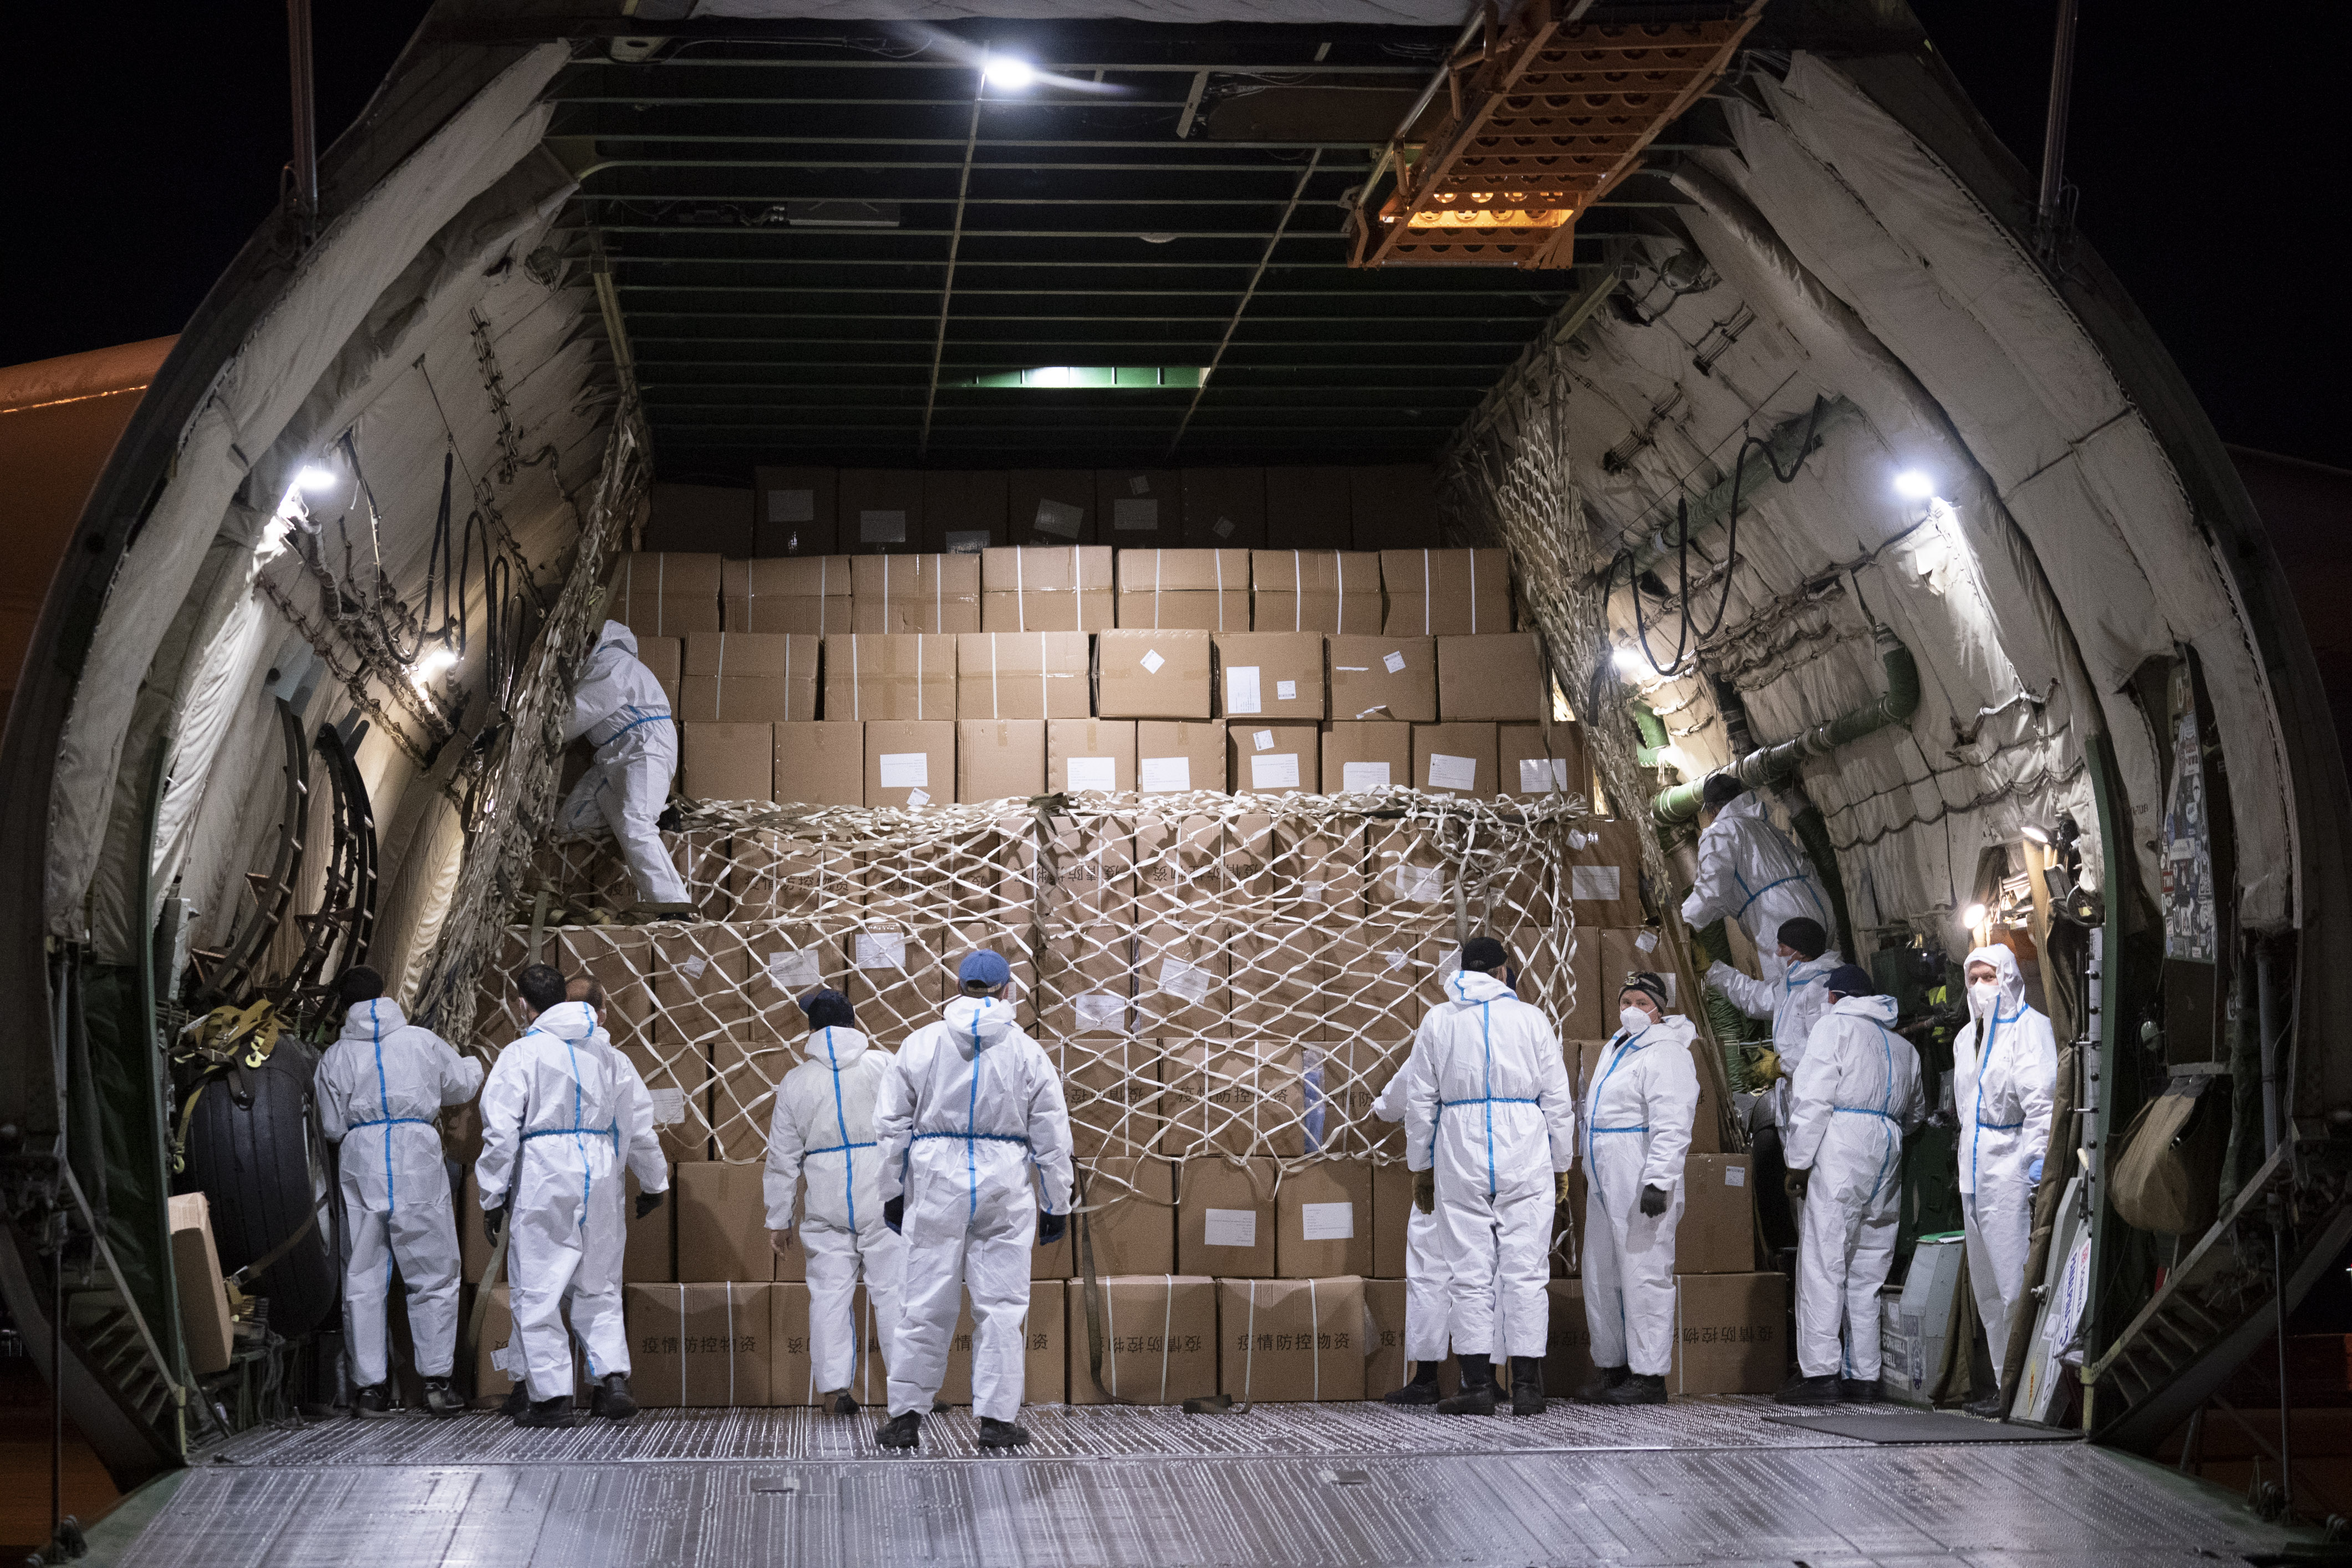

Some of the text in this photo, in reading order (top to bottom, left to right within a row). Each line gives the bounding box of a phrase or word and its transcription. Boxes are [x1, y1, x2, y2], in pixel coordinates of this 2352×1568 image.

[2163, 874, 2173, 888] TWA
[1063, 1087, 1143, 1104] 疫情防控
[2064, 1251, 2078, 1321] PANALPINA
[2076, 1265, 2086, 1316] SCHENKER
[642, 1336, 756, 1354] 疫情防控物资
[1100, 1335, 1202, 1354] 疫情防控物
[1237, 1332, 1350, 1351] 疫情防控物资
